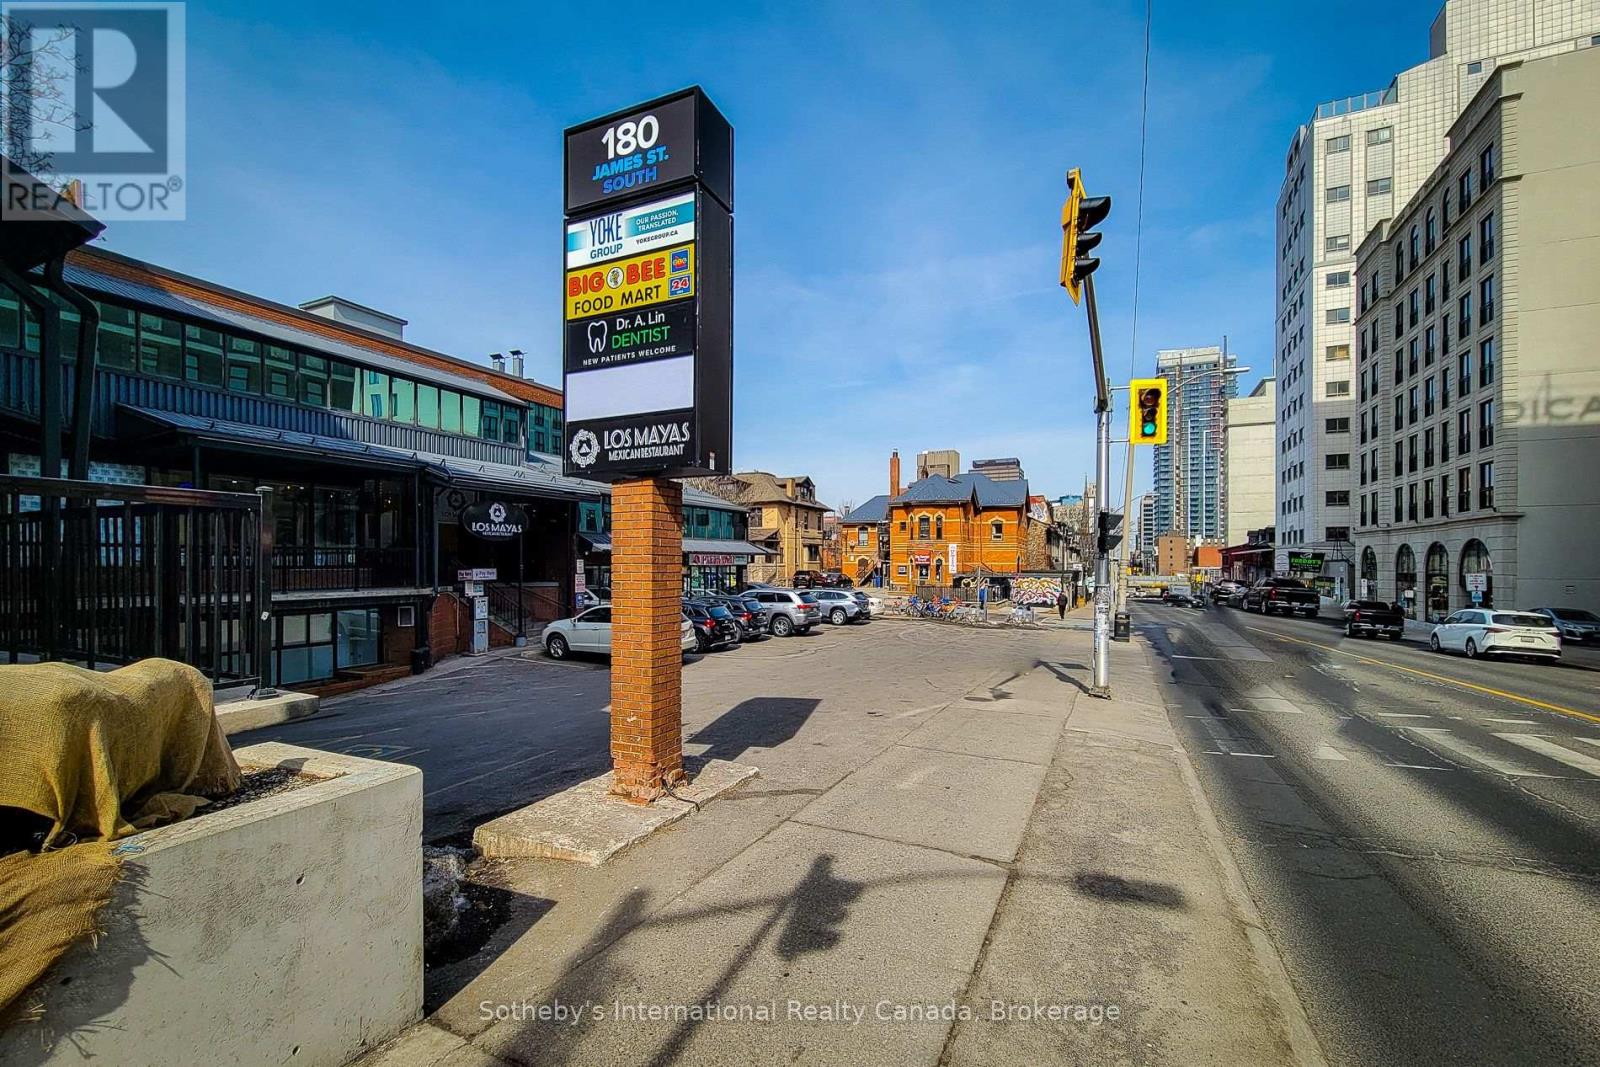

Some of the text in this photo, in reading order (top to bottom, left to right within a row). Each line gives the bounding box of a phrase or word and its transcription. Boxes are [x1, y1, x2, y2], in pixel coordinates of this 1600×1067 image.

[602, 115, 659, 160] 180
[592, 146, 670, 181] JAMES ST.
[603, 166, 657, 194] SOUTH
[590, 213, 623, 247] YOKE
[635, 216, 649, 226] OUR
[638, 217, 677, 231] TRANSLATED
[636, 230, 679, 245] YOKEGROUP.CA
[590, 243, 623, 260] GROUP
[568, 257, 666, 298] BIG BEE
[672, 277, 689, 291] 24
[574, 285, 662, 315] FOOD MART
[616, 311, 665, 331] Dr. A. Lin
[611, 325, 671, 349] DENTIST
[583, 345, 676, 366] NEW PATIENTS WELCOME
[604, 422, 690, 449] LOS MAYAS
[608, 444, 685, 461] MEXICAN RESTAURANT
[472, 522, 522, 533] LOS MAYAS
